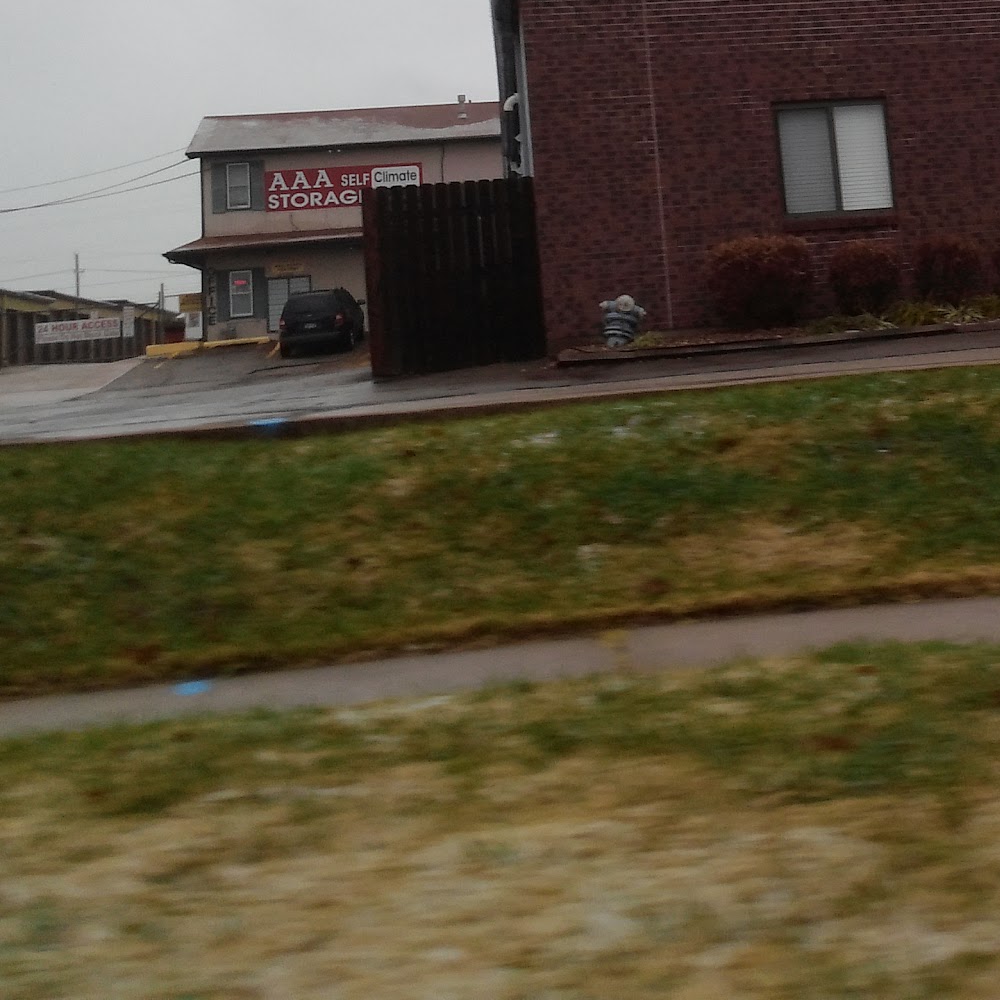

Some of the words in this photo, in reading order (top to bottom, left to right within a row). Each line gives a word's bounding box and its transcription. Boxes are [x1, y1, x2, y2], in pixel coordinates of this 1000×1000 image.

[268, 169, 334, 191] AAA
[341, 173, 370, 187] SELF
[374, 169, 417, 183] Climate
[81, 319, 118, 329] ACCESS
